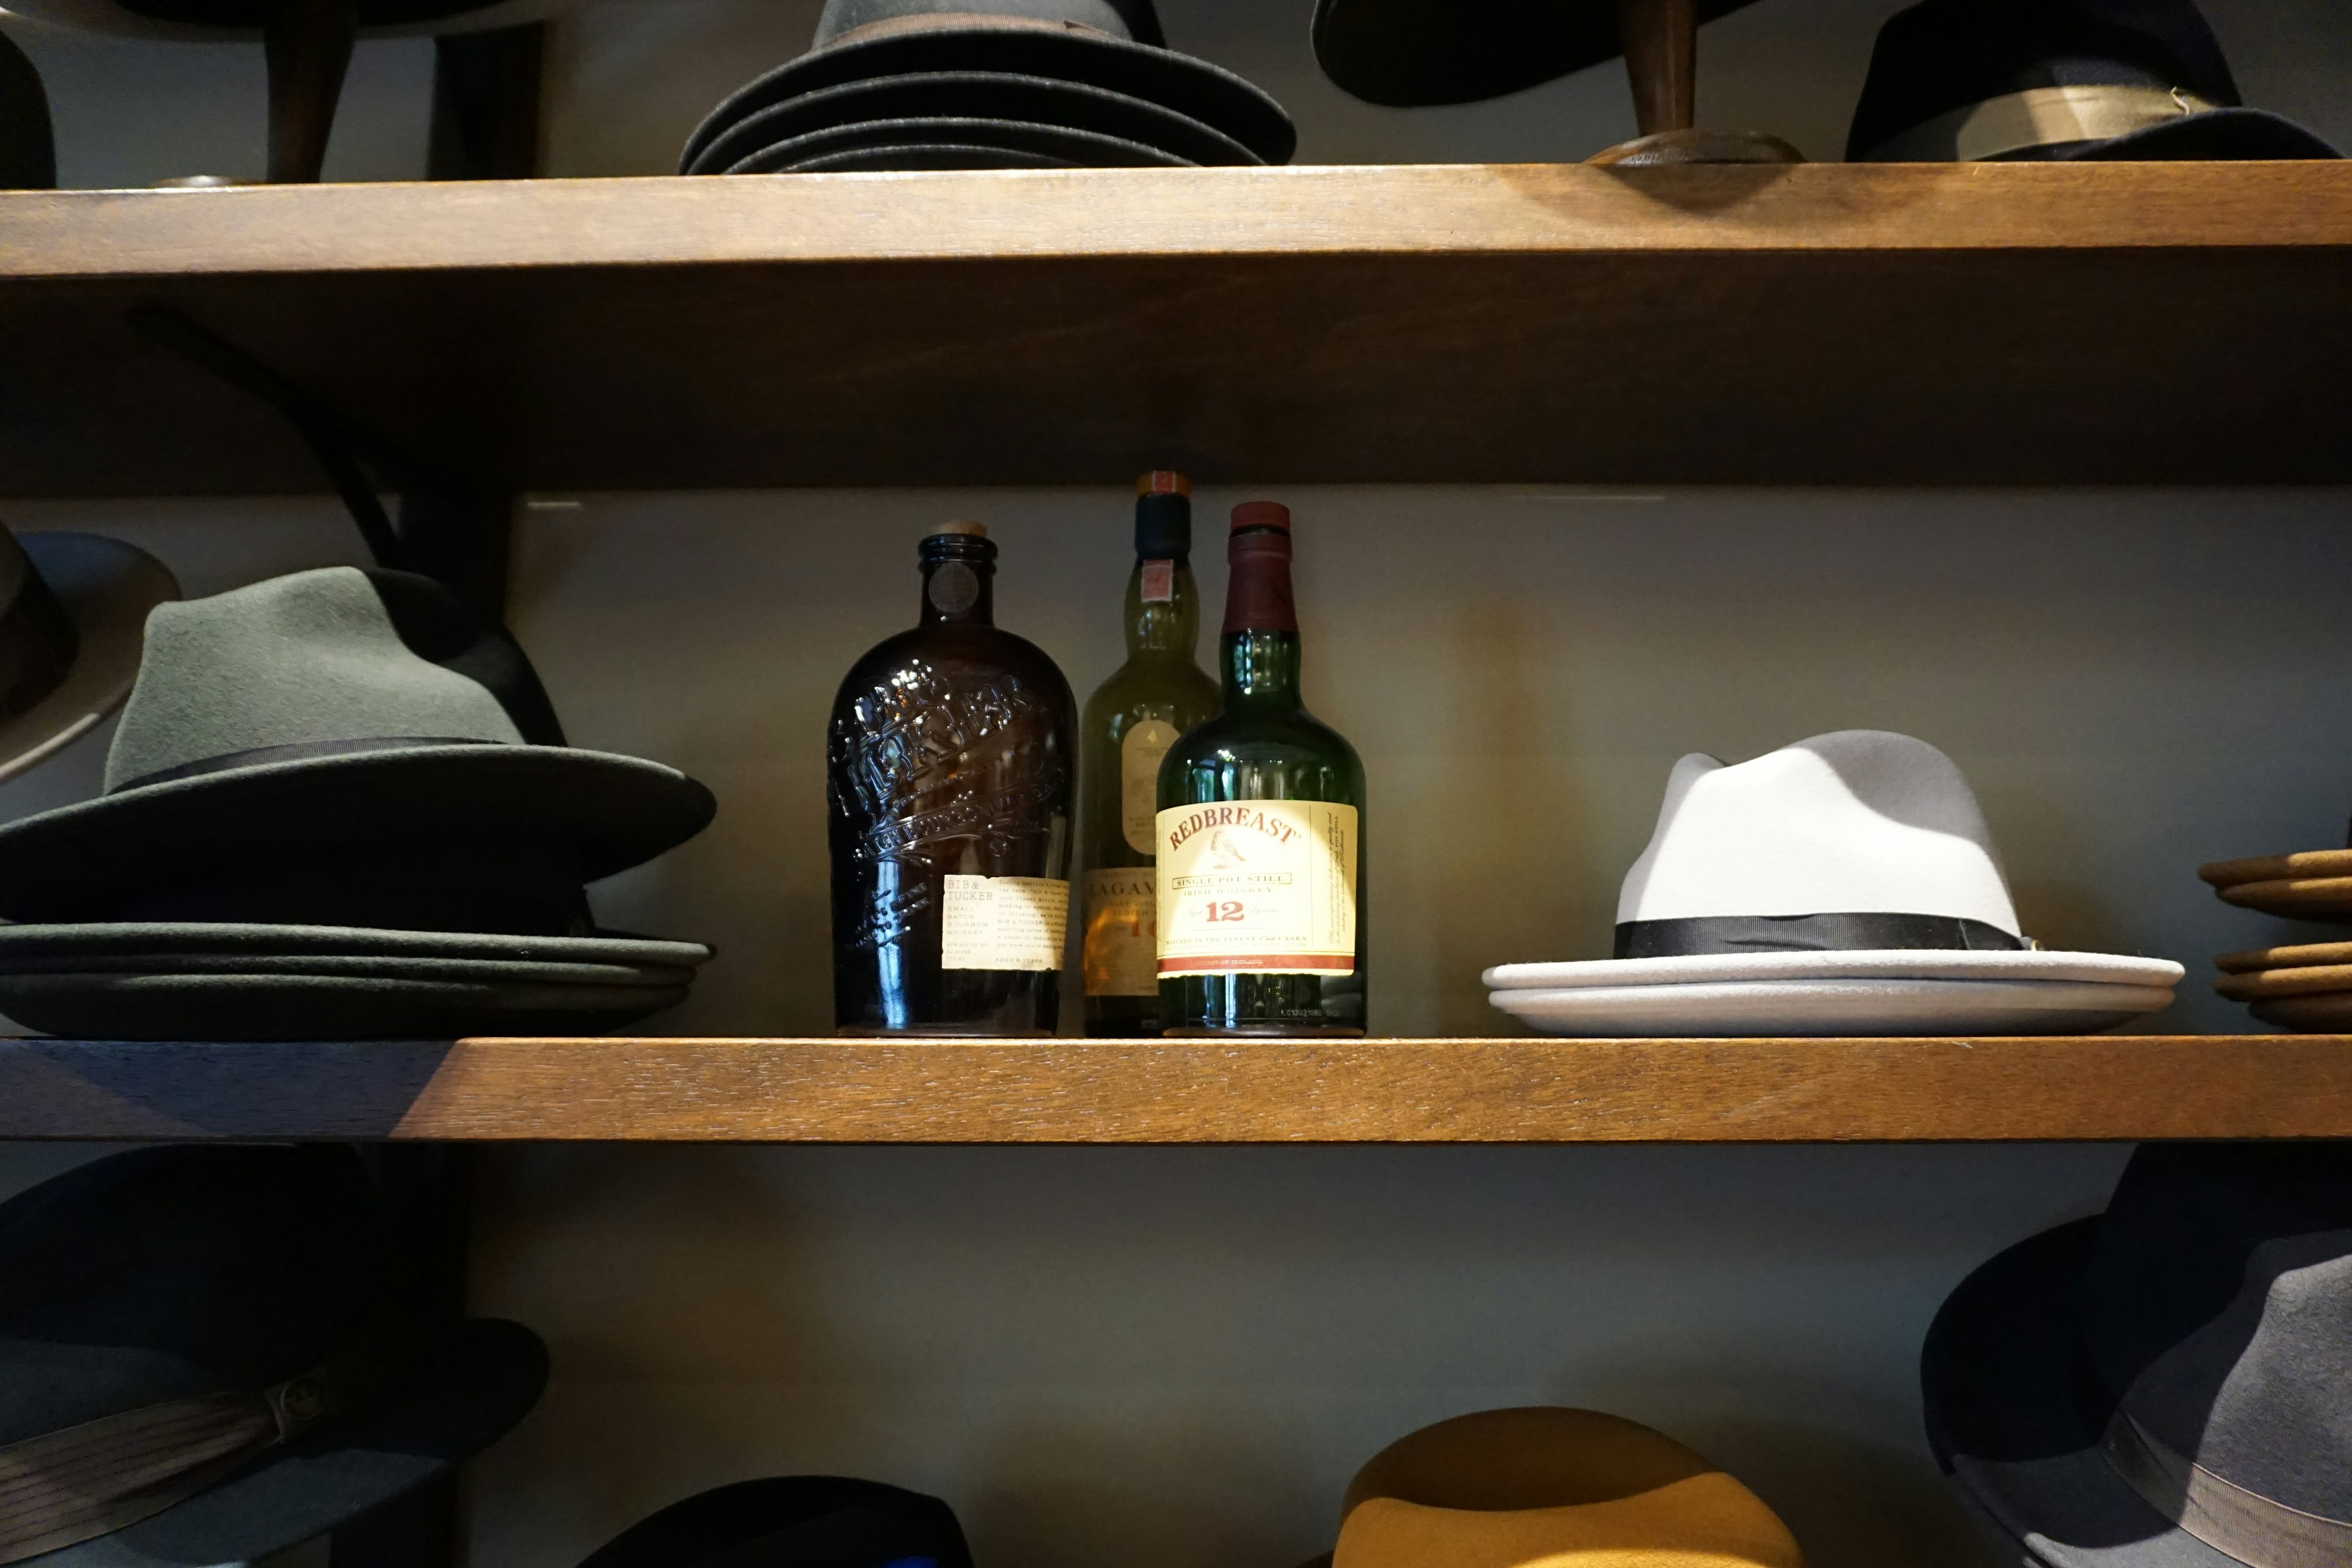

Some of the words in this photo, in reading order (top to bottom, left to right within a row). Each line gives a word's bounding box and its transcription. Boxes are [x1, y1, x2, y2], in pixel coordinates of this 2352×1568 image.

[1169, 807, 1297, 851] REDBREAST
[948, 880, 969, 889] BIB
[971, 881, 979, 889] &
[1176, 877, 1213, 886] SINGLE
[948, 891, 993, 900] TUCKER
[1182, 908, 1203, 917] Aged
[1205, 901, 1245, 922] 12
